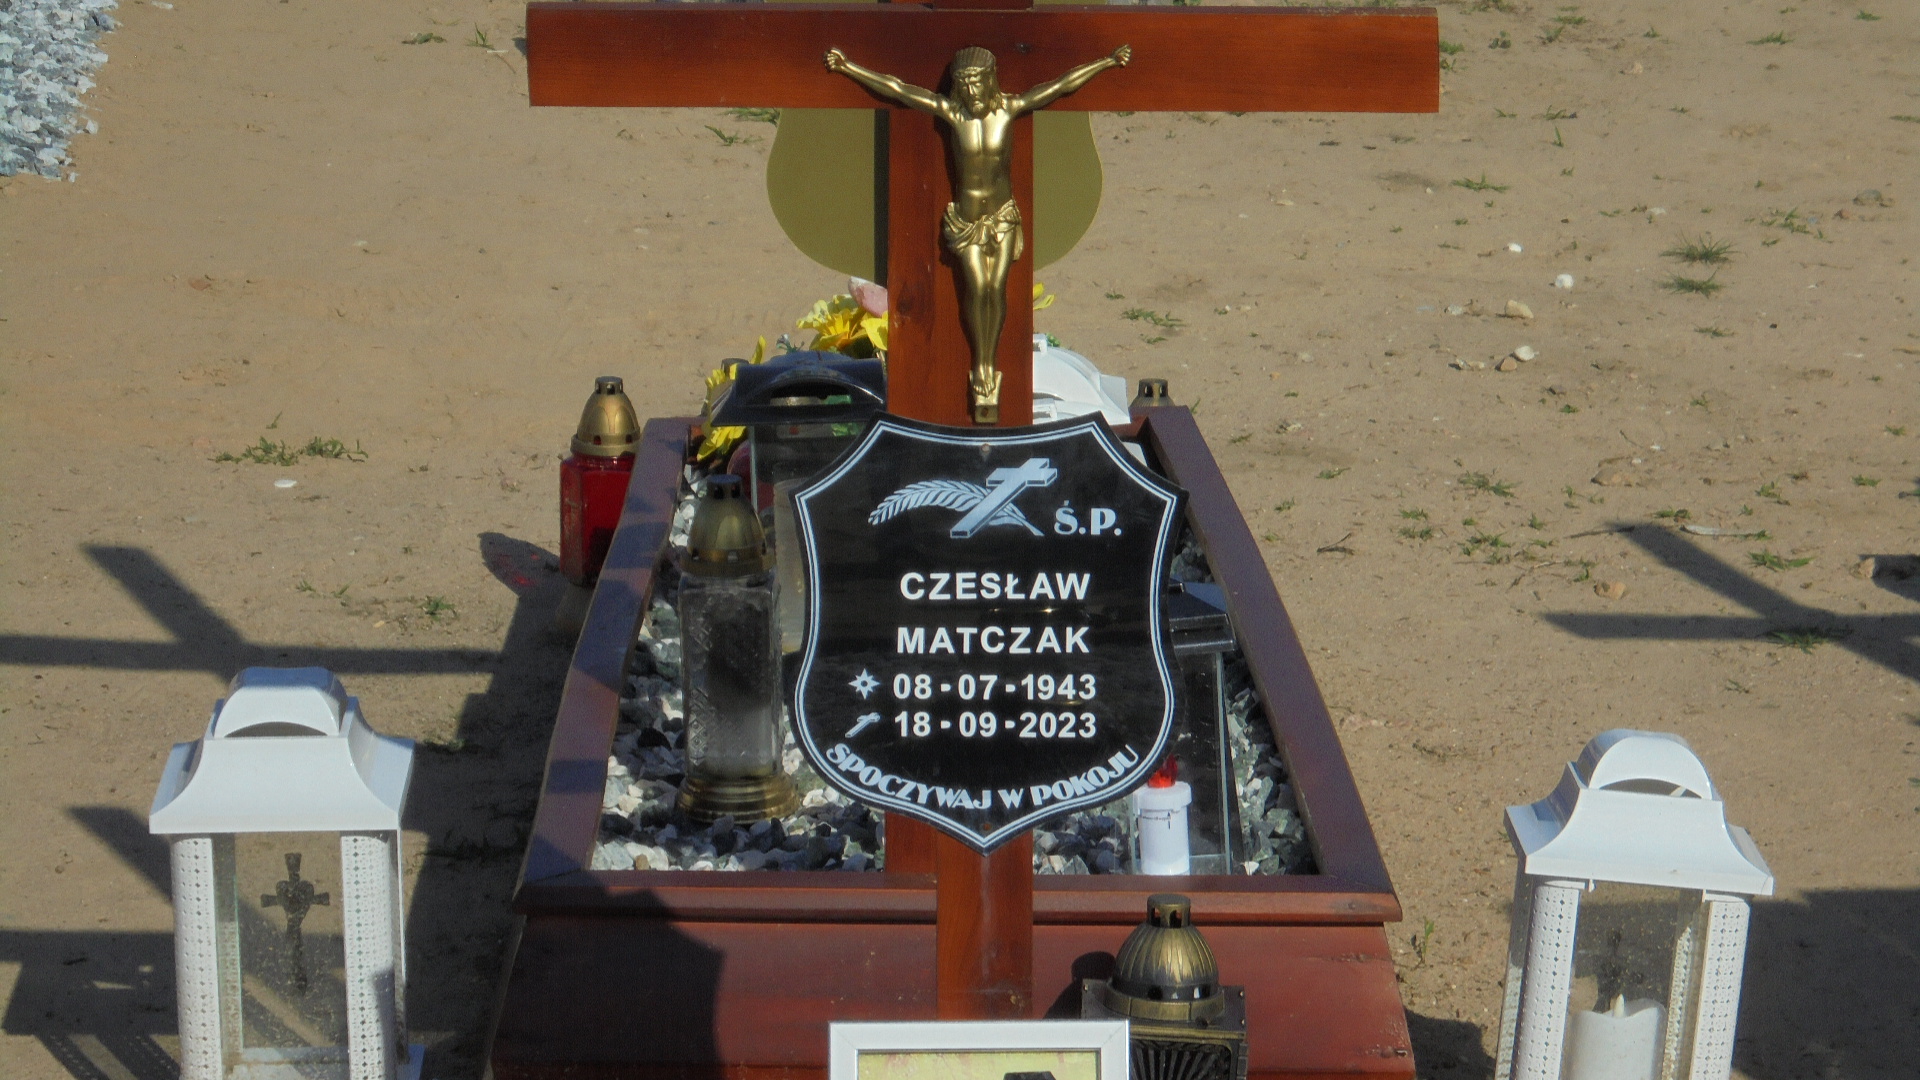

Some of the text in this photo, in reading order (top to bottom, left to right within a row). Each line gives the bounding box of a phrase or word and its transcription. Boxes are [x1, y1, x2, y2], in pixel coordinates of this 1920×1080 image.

[1054, 500, 1122, 536] Ś.P.
[900, 572, 1091, 600] CZESŁAW
[896, 626, 1090, 654] MATCZAK
[826, 743, 1139, 810] SPOCZYWAJ W POKOJU
